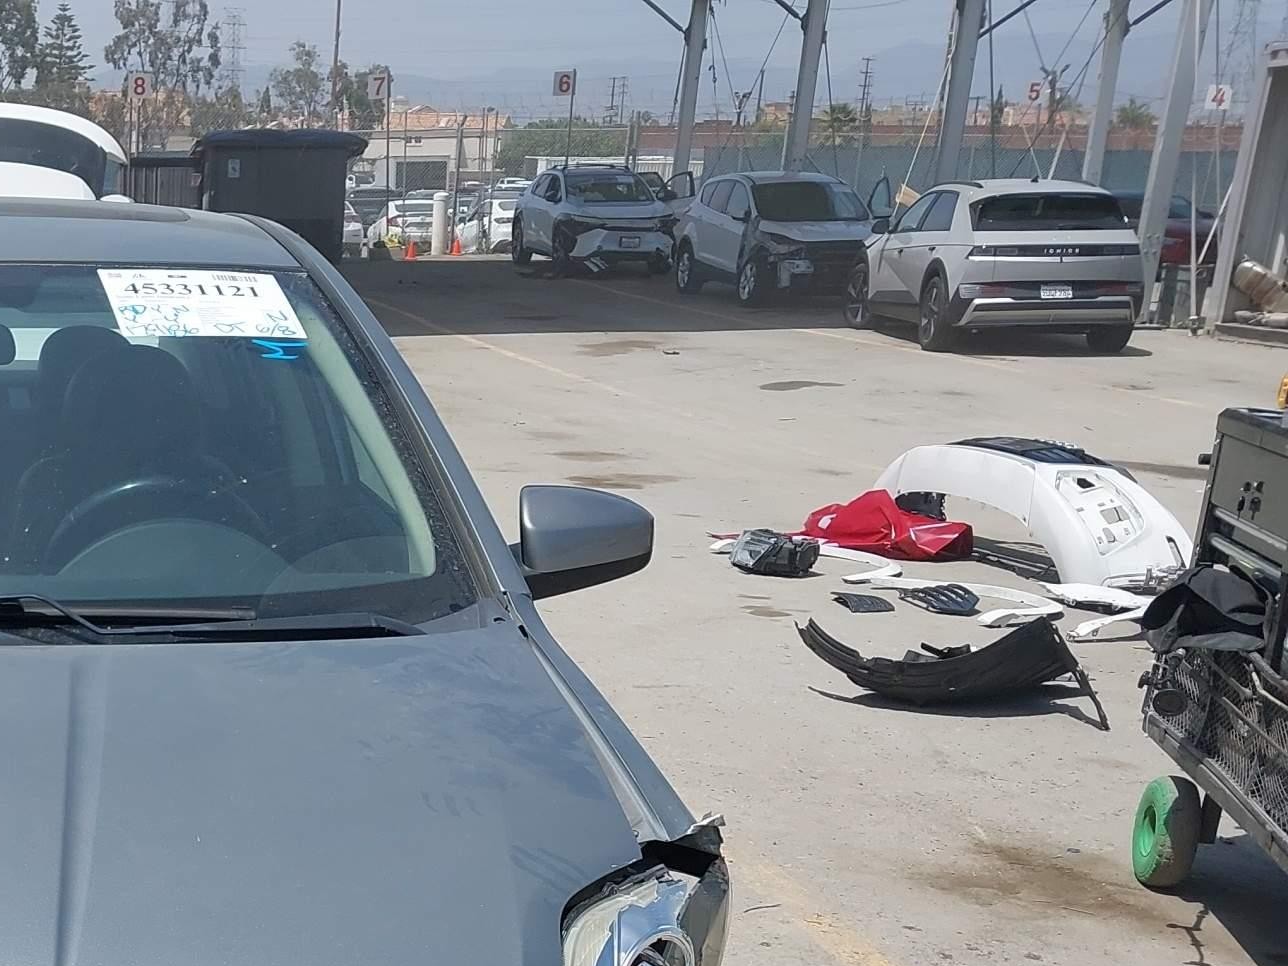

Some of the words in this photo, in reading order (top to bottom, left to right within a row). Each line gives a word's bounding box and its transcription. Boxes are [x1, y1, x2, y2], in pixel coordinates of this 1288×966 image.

[134, 76, 145, 95] 8
[373, 76, 386, 96] 7
[559, 74, 571, 93] 6
[1028, 82, 1041, 101] 5
[1211, 87, 1225, 106] 4
[123, 282, 259, 298] 45331121
